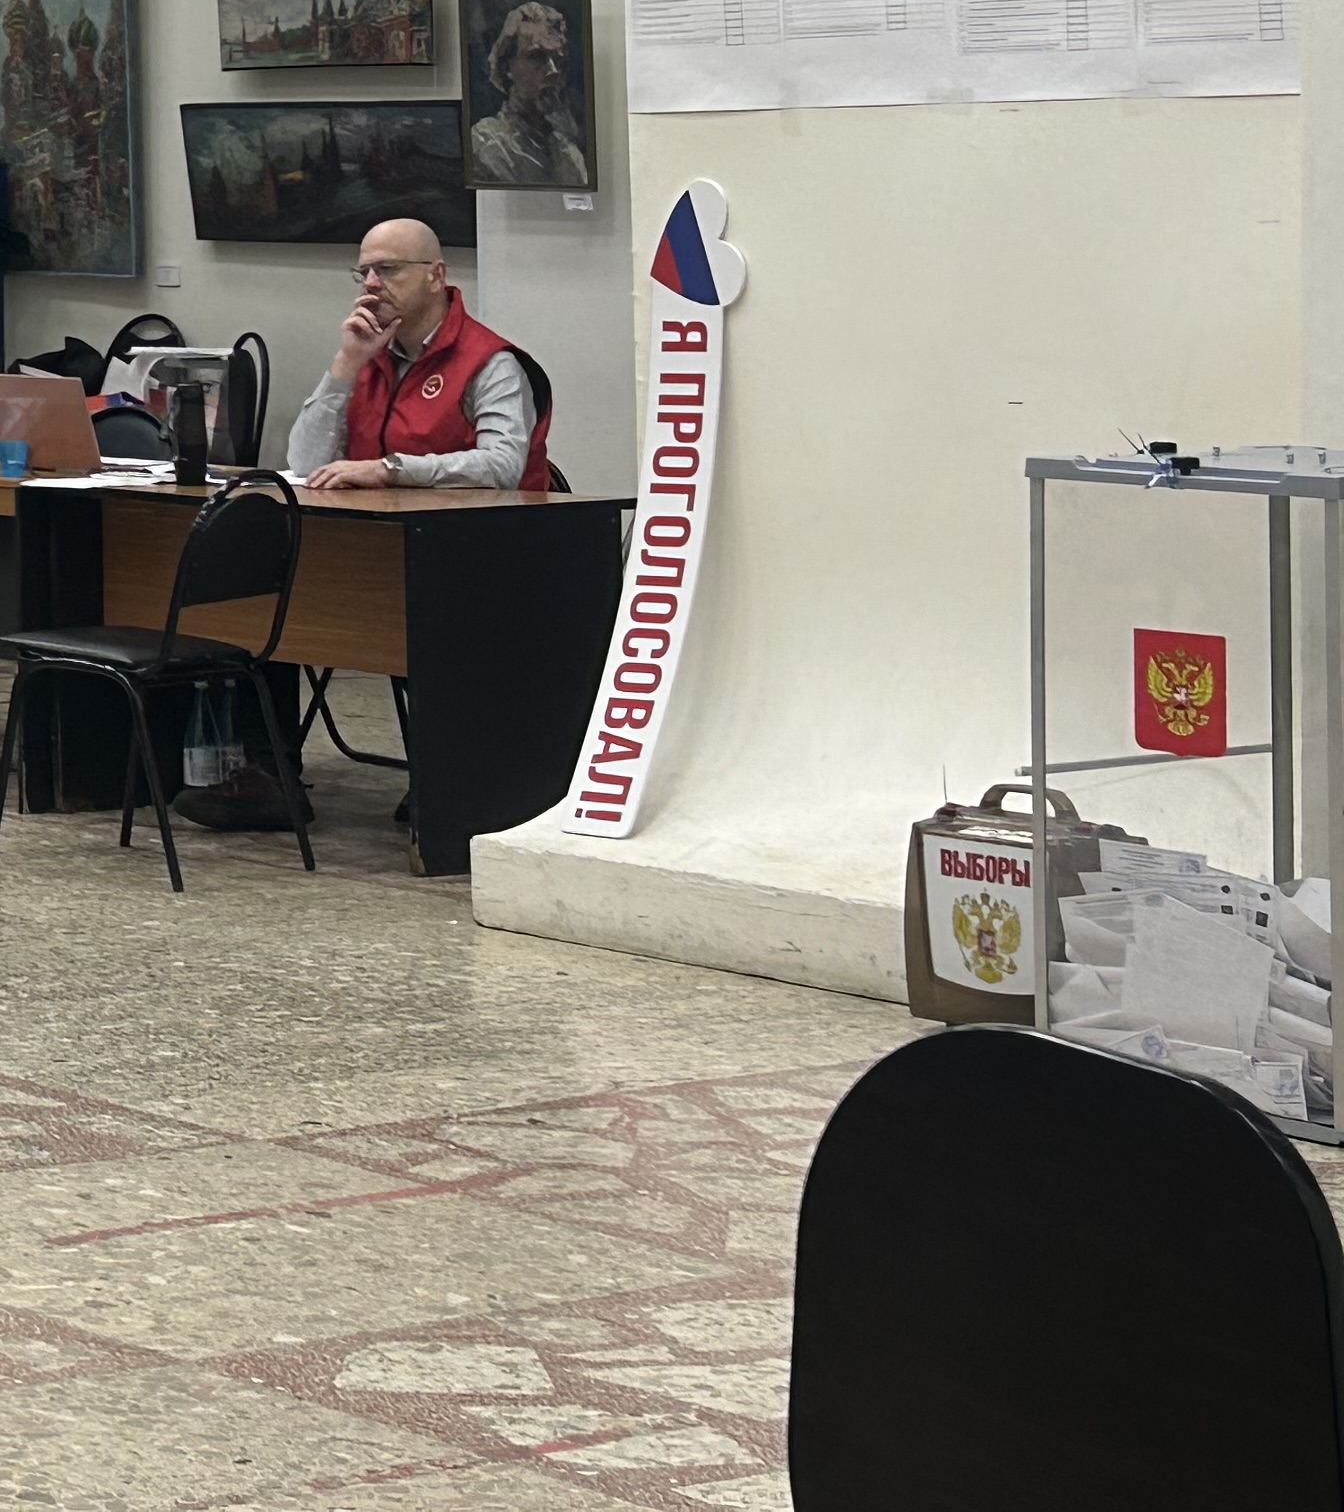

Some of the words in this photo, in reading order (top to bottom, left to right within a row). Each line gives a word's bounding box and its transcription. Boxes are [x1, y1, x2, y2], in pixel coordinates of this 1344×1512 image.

[661, 320, 708, 353] Я
[574, 373, 706, 823] ПРОГОЛОСОВАЛ!
[939, 848, 1032, 888] ВЫБОРЫ
